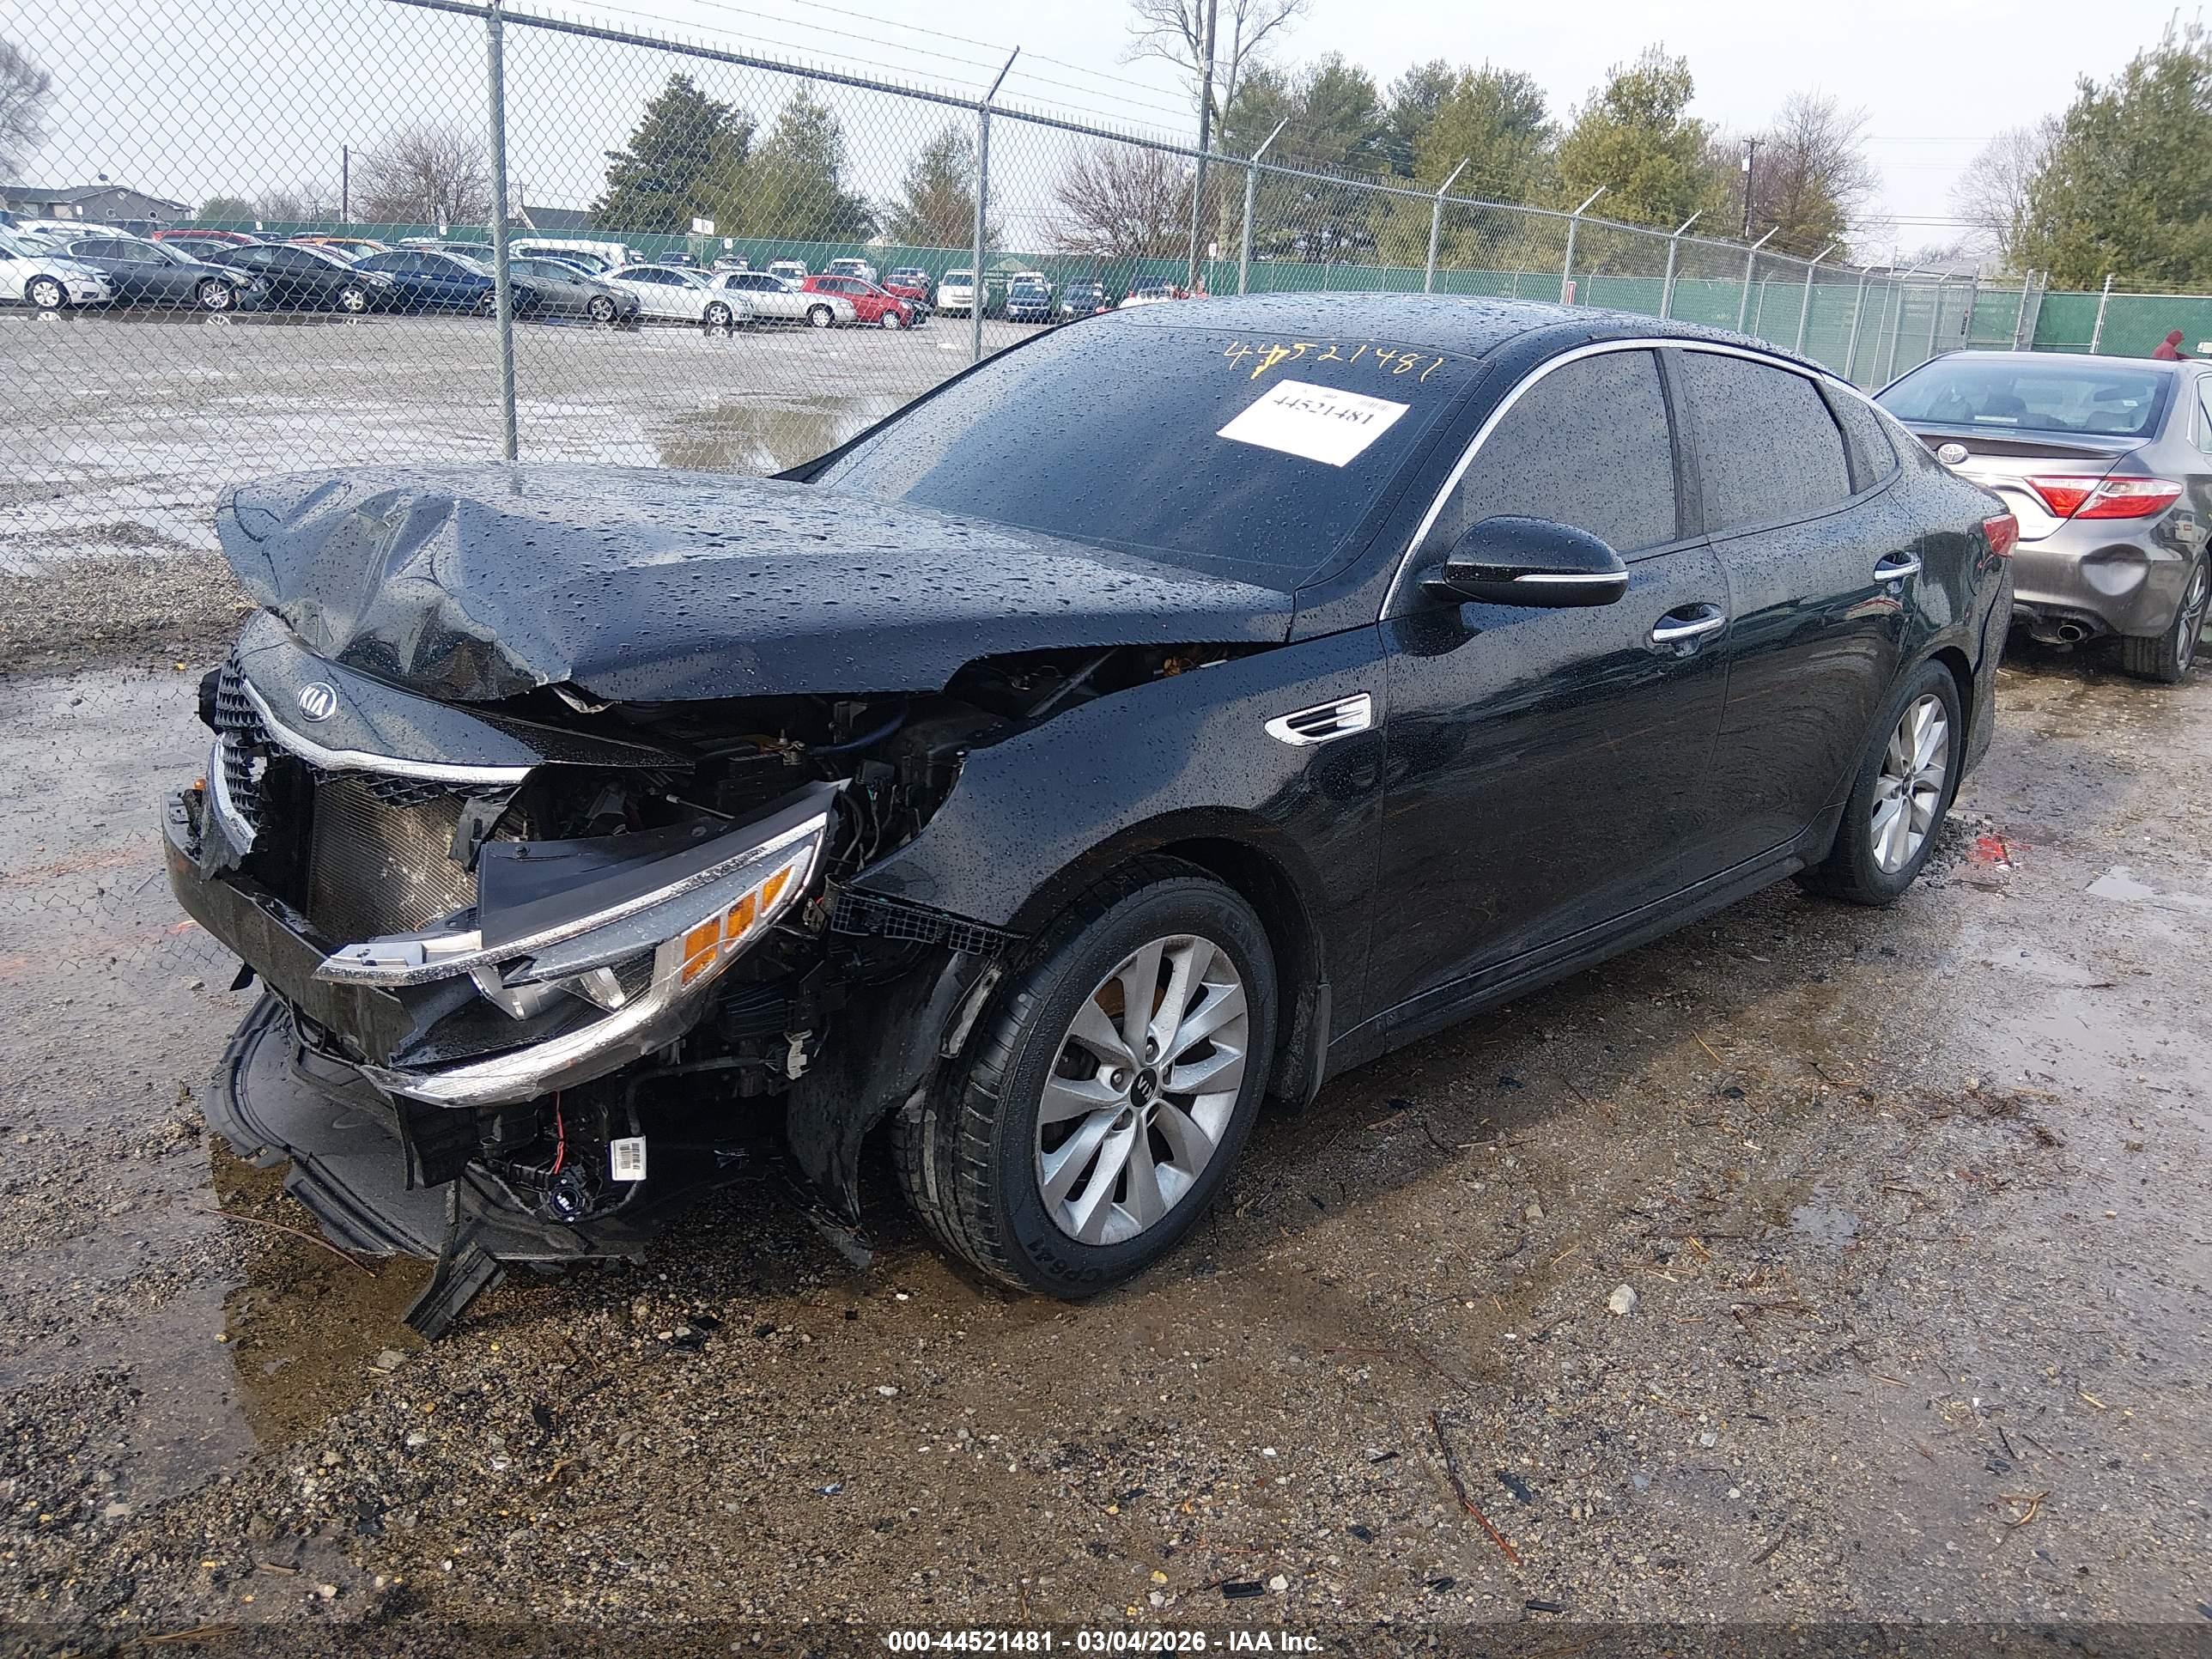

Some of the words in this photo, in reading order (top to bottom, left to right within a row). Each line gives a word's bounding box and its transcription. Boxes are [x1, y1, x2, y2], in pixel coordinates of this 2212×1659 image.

[1273, 396, 1375, 425] 44521481
[299, 686, 329, 716] KIA
[1137, 1075, 1154, 1102] KIA
